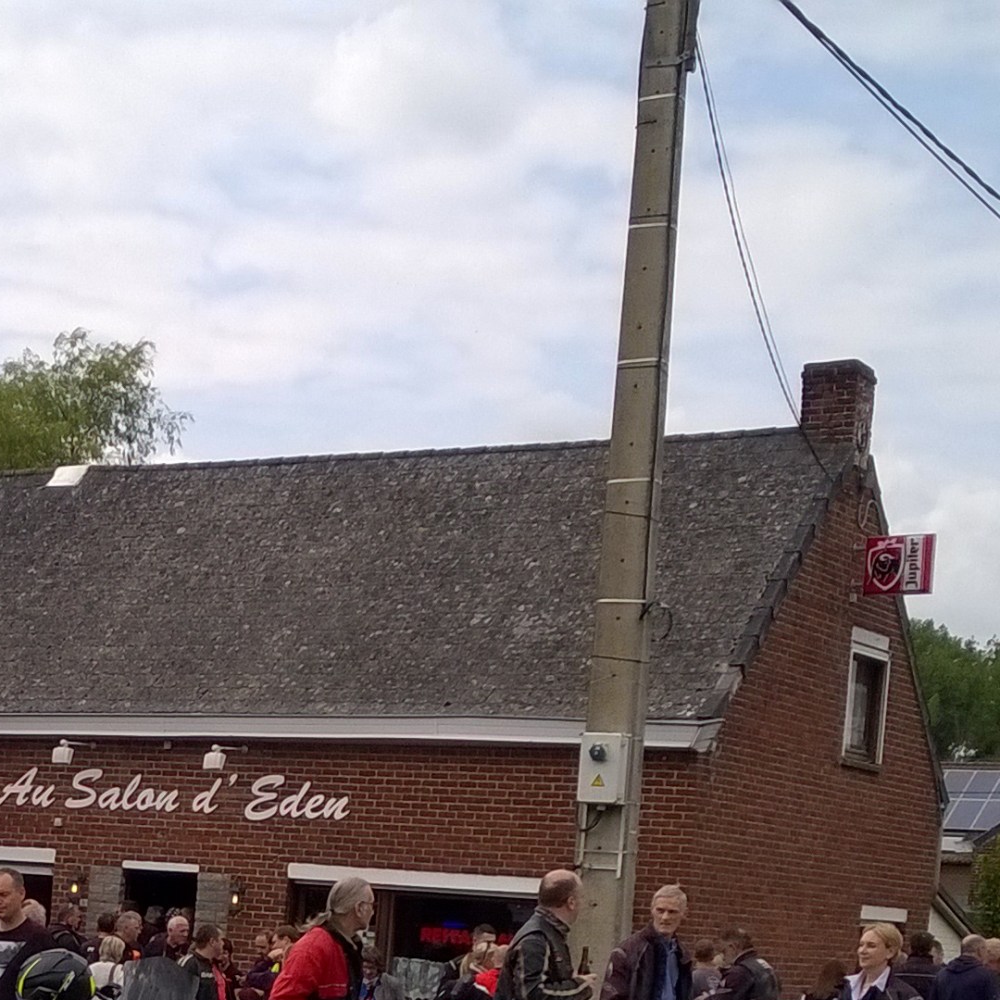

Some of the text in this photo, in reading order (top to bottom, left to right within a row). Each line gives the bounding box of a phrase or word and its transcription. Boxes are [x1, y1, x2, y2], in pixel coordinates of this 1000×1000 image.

[905, 537, 920, 588] Jupiler
[64, 768, 180, 813] Salon
[244, 774, 350, 821] Eden
